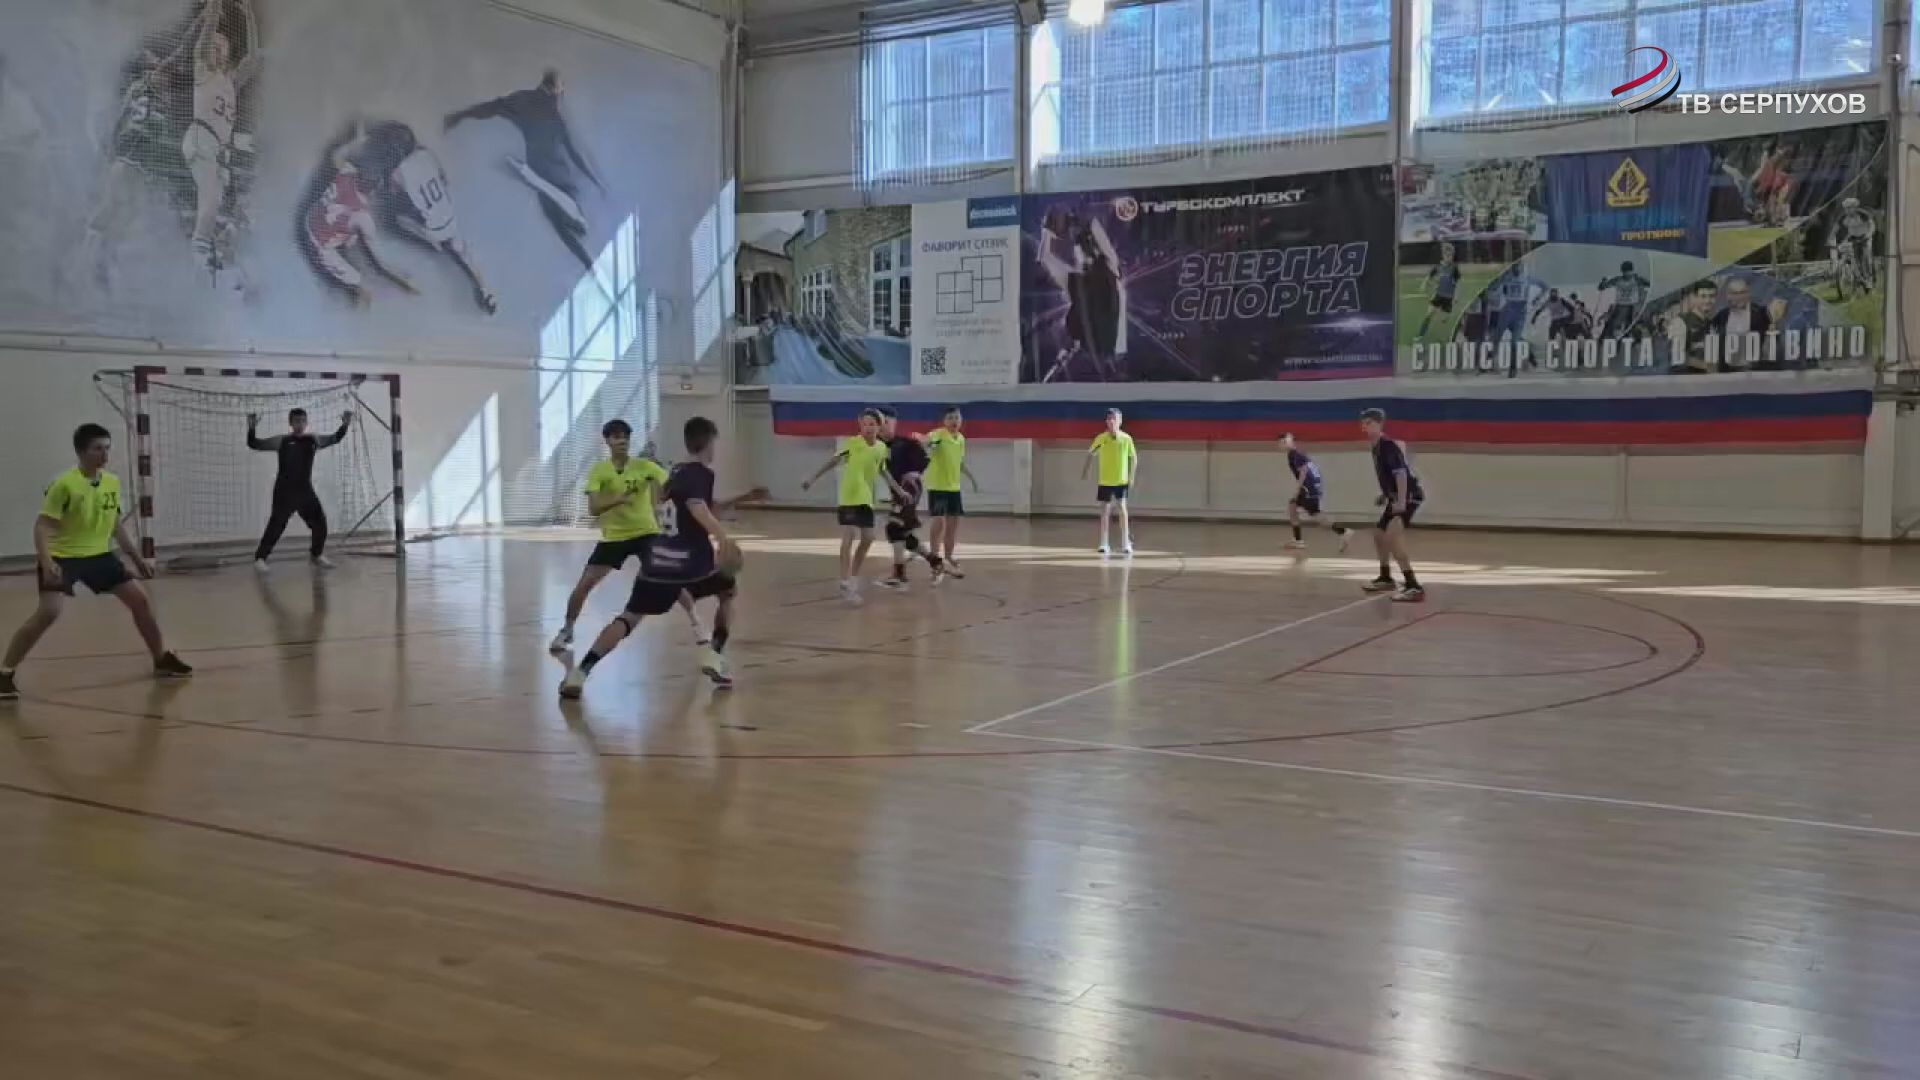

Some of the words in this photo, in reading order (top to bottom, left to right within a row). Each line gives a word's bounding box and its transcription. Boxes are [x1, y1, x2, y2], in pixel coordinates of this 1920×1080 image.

[419, 178, 442, 210] 10
[1140, 189, 1306, 213] ТУРБОКОМПЛЕКТ
[1178, 241, 1369, 286] ЭНЕРГИЯ
[1170, 278, 1362, 321] СПОРТА
[1411, 340, 1530, 370] СПОНСОР
[1546, 336, 1653, 369] СПОРТА
[1704, 325, 1866, 365] ПРОТВИНО
